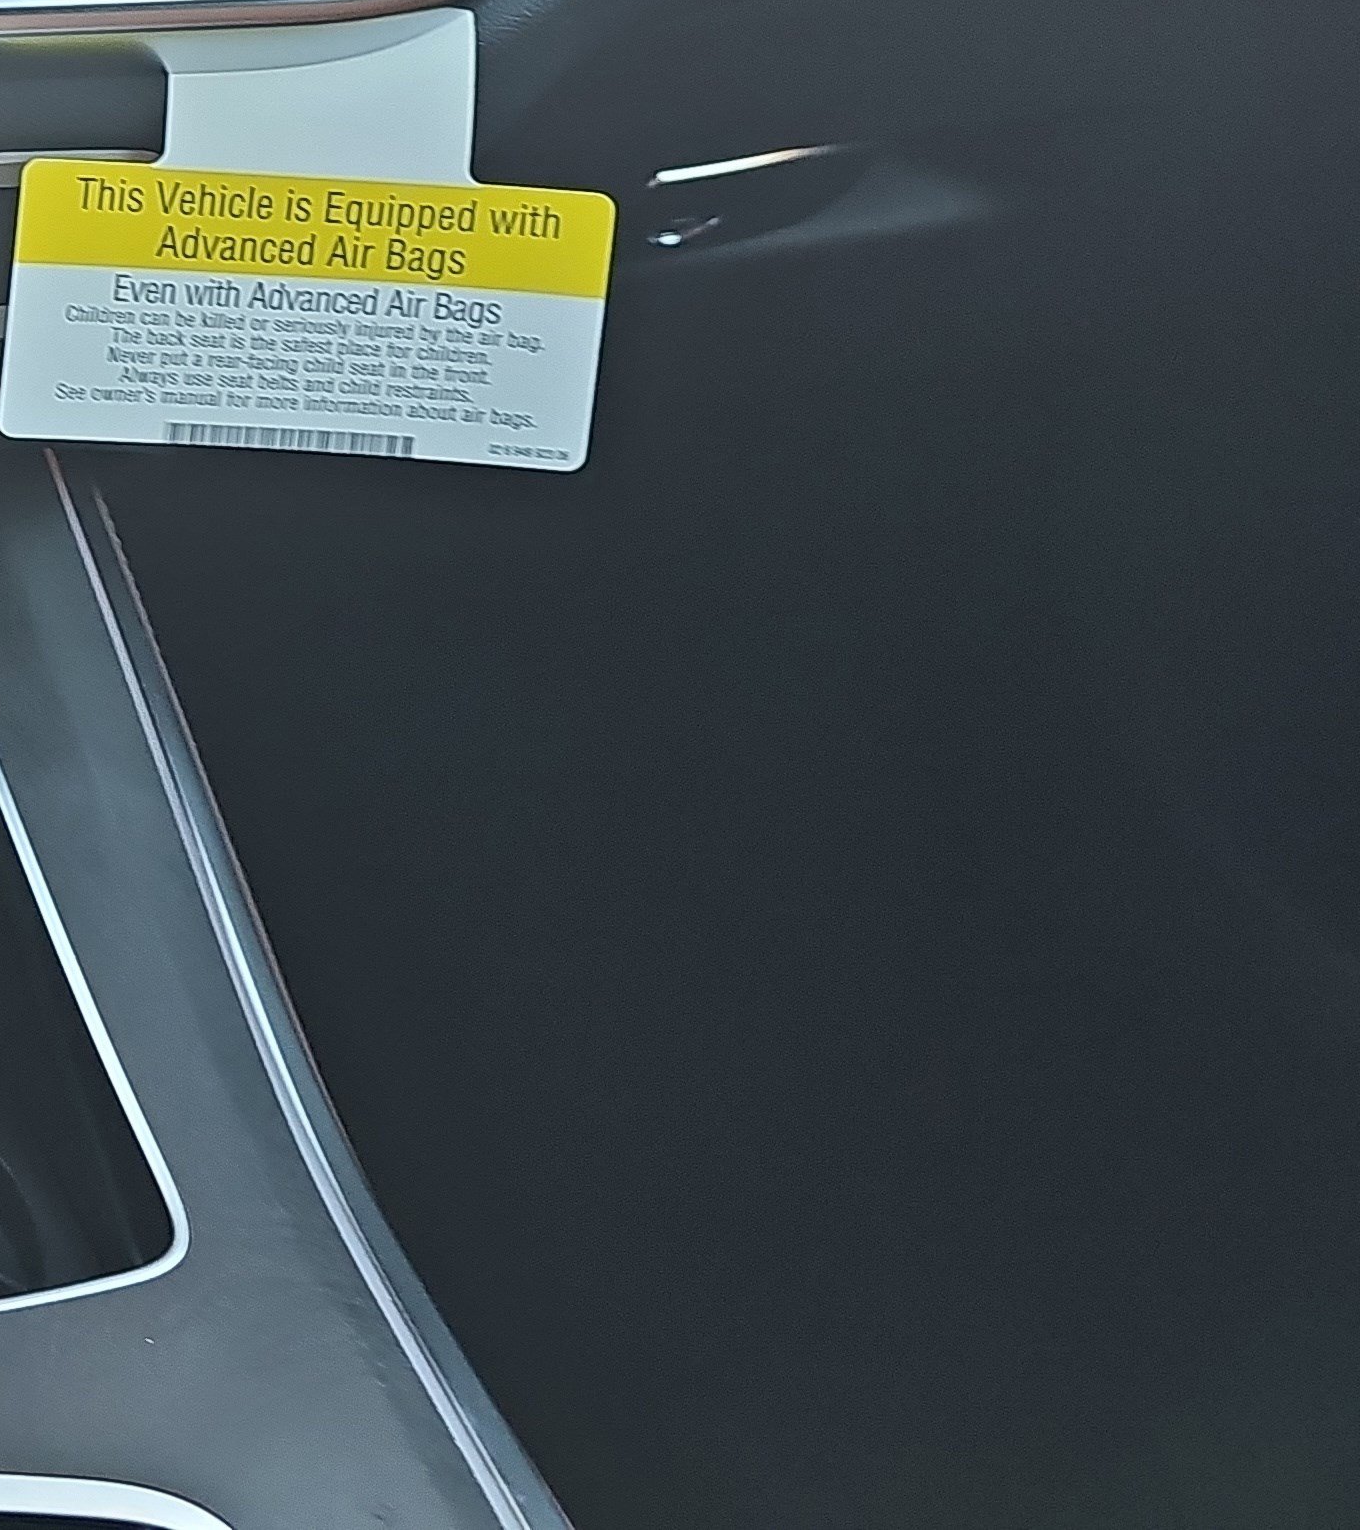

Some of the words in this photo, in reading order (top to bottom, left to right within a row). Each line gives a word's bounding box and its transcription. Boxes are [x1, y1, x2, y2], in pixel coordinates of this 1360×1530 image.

[76, 176, 145, 213] This
[156, 180, 274, 220] Vehicle
[284, 189, 313, 222] is
[325, 191, 478, 236] Equipped
[488, 203, 561, 239] with
[155, 225, 317, 266] Advanced
[326, 235, 376, 268] Air
[386, 238, 467, 280] Bags
[113, 273, 176, 304] Even
[184, 278, 240, 308] with
[247, 281, 380, 316] Advanced
[384, 289, 428, 319] Air
[434, 292, 503, 328] Bags
[65, 304, 135, 325] Children
[140, 311, 169, 327] can
[175, 310, 196, 328] be
[201, 312, 246, 331] killed
[250, 317, 267, 332] or
[271, 318, 352, 340] seriously
[355, 322, 415, 343] injured
[419, 325, 441, 345] by
[446, 327, 474, 345] the
[478, 332, 504, 347] air
[111, 326, 143, 345] The
[146, 328, 186, 348] back
[189, 332, 227, 350] seat
[230, 333, 247, 351] is
[250, 334, 278, 353] the
[281, 336, 334, 356] safest
[336, 338, 382, 359] place
[386, 341, 414, 359] for
[107, 345, 157, 366] Never
[160, 350, 189, 370] put
[193, 352, 205, 367] a
[207, 353, 298, 377] rear-facing
[302, 357, 344, 376] child
[348, 361, 385, 379] seat
[389, 363, 407, 379] in
[411, 364, 440, 382] the
[118, 366, 180, 389] Always
[183, 371, 213, 387] use
[217, 372, 254, 391] seat
[257, 373, 299, 393] belts
[303, 376, 334, 394] and
[338, 377, 382, 397] child
[55, 381, 88, 401] See
[90, 387, 157, 404] owner's
[160, 389, 222, 408] manual
[226, 391, 253, 408] for
[254, 395, 299, 412] more
[303, 396, 403, 418] information
[406, 401, 458, 423] about
[460, 404, 488, 423] air
